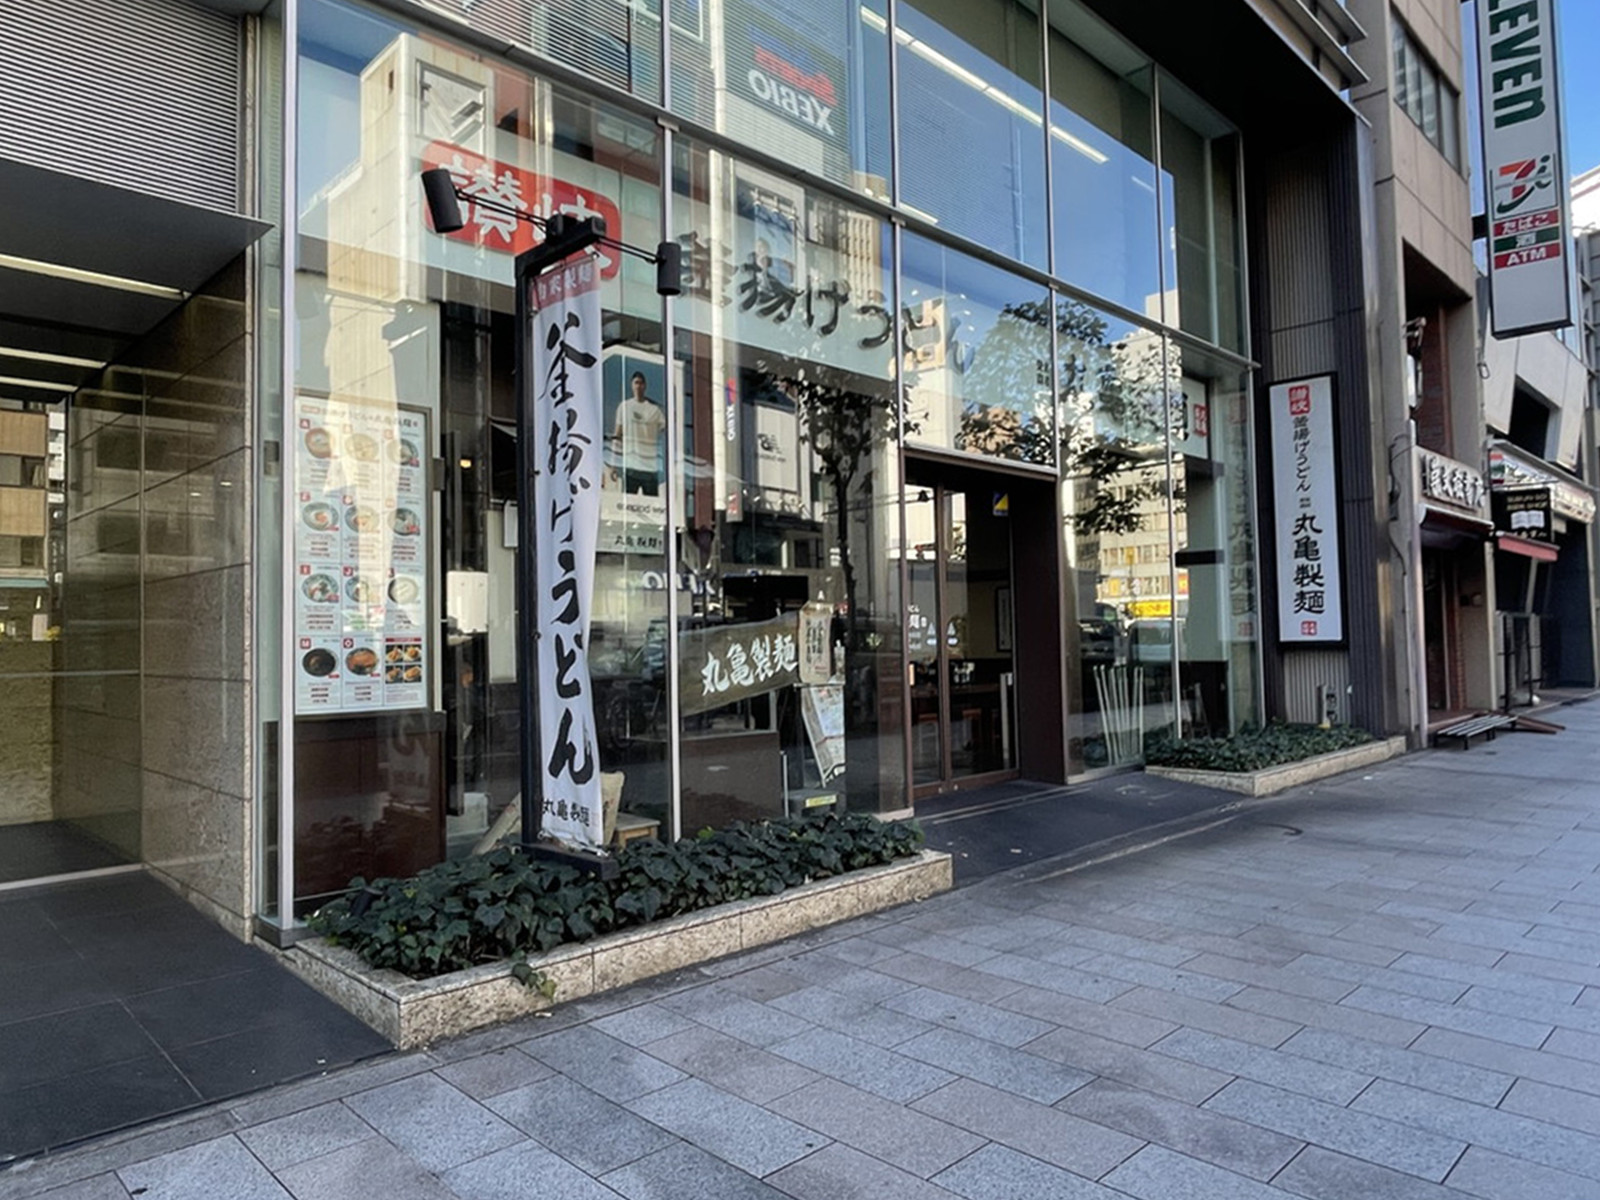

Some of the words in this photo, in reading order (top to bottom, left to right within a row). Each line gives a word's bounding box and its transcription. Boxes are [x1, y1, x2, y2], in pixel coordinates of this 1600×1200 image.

[1502, 213, 1550, 235] たばこ
[1507, 246, 1548, 266] ATM
[1292, 512, 1326, 615] 丸亀製麺
[701, 633, 799, 696] 丸亀製麺
